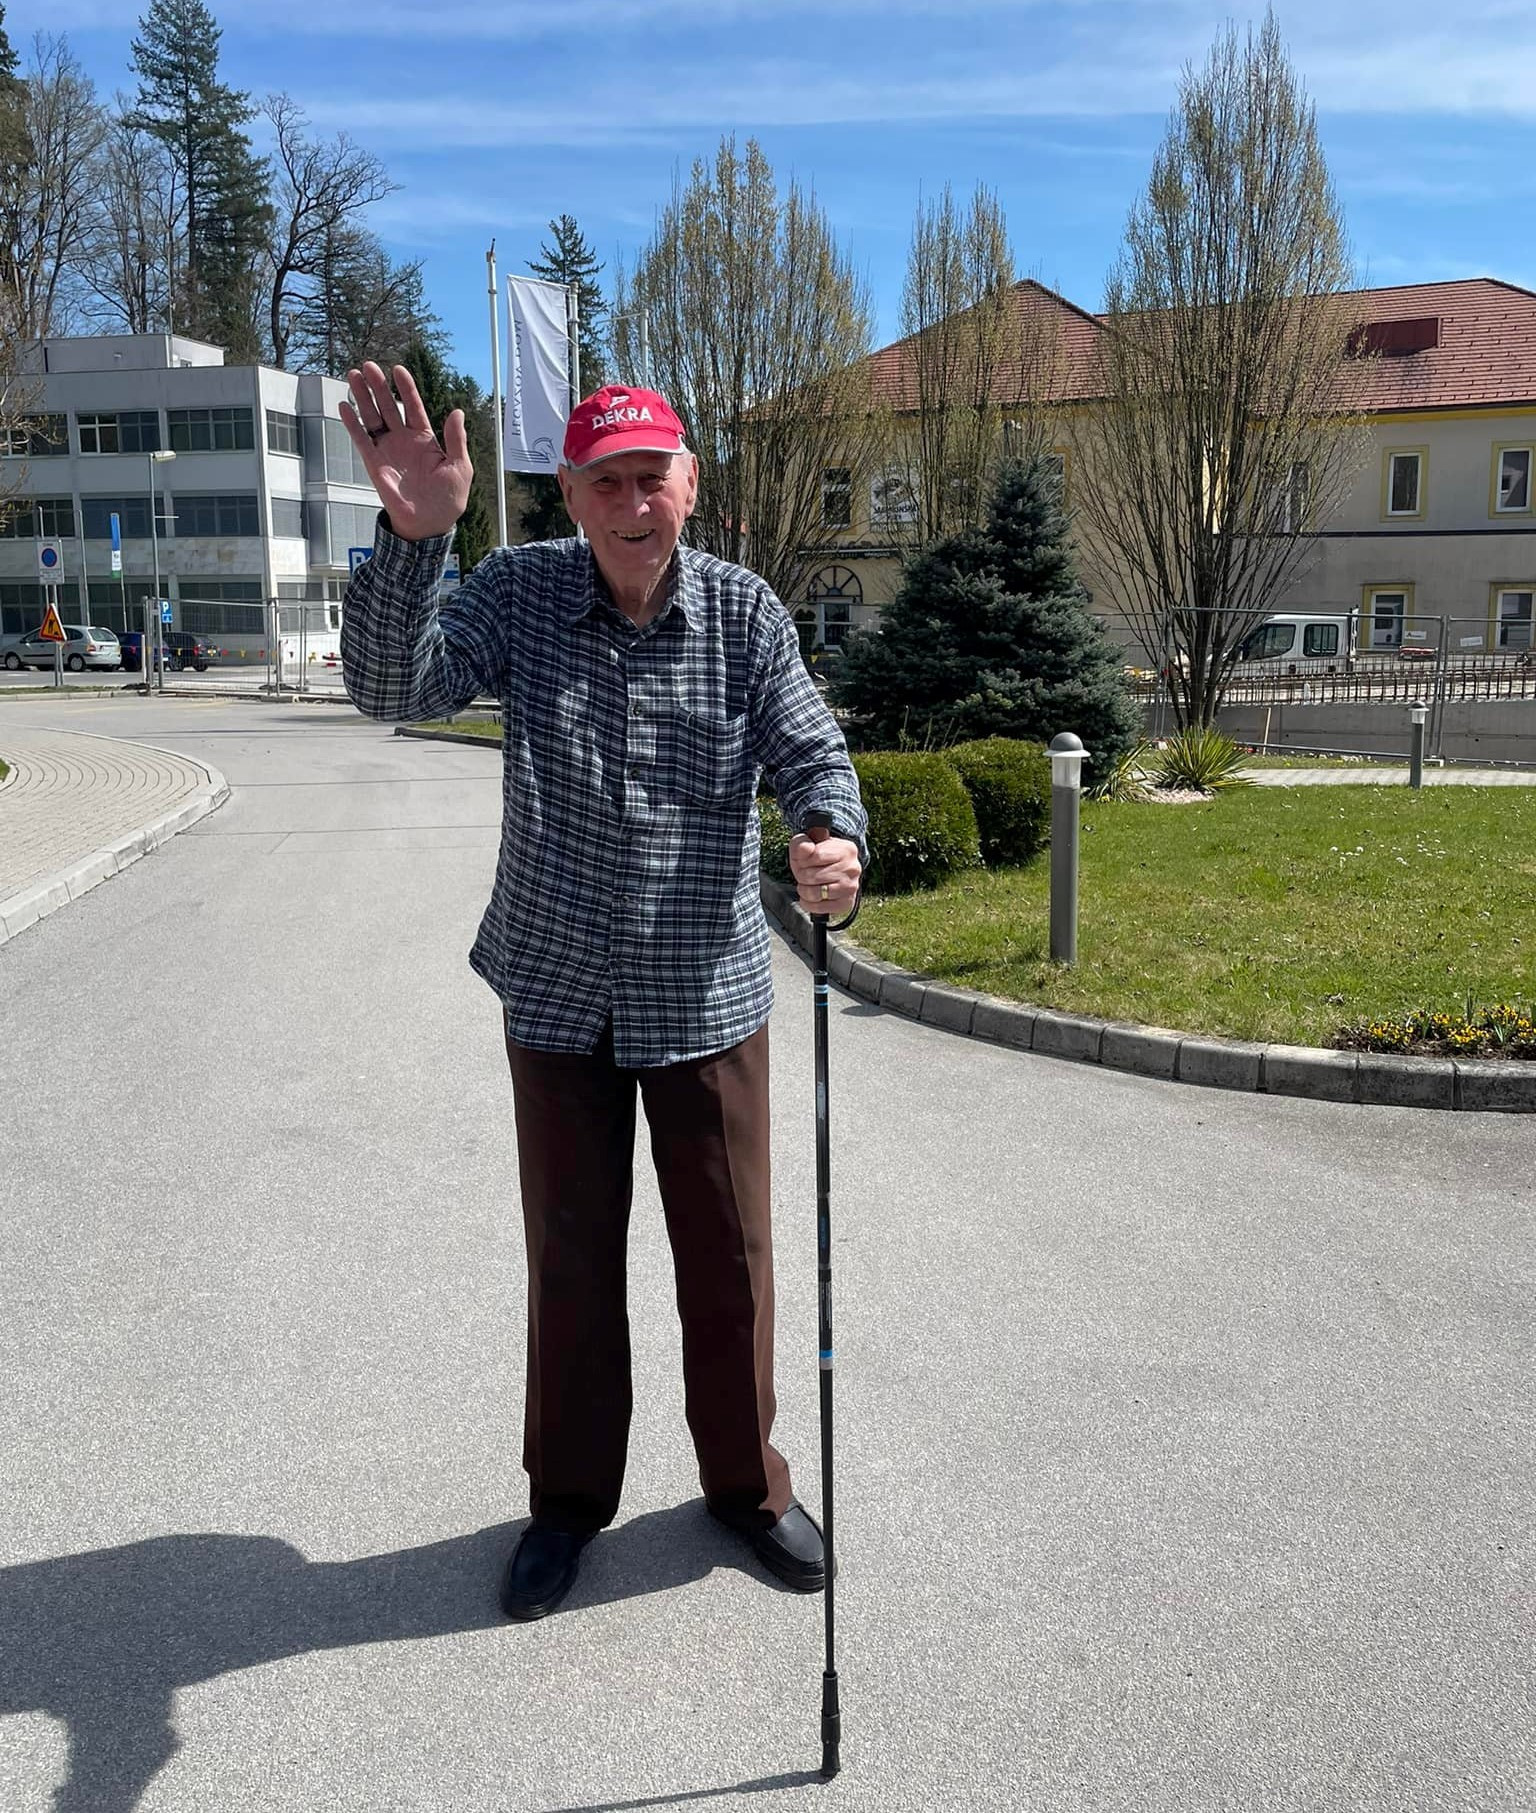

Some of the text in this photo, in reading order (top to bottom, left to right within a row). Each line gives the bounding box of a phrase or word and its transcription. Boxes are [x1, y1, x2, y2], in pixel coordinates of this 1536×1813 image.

[592, 407, 654, 430] DEKRA
[351, 551, 366, 574] P
[162, 601, 169, 613] P
